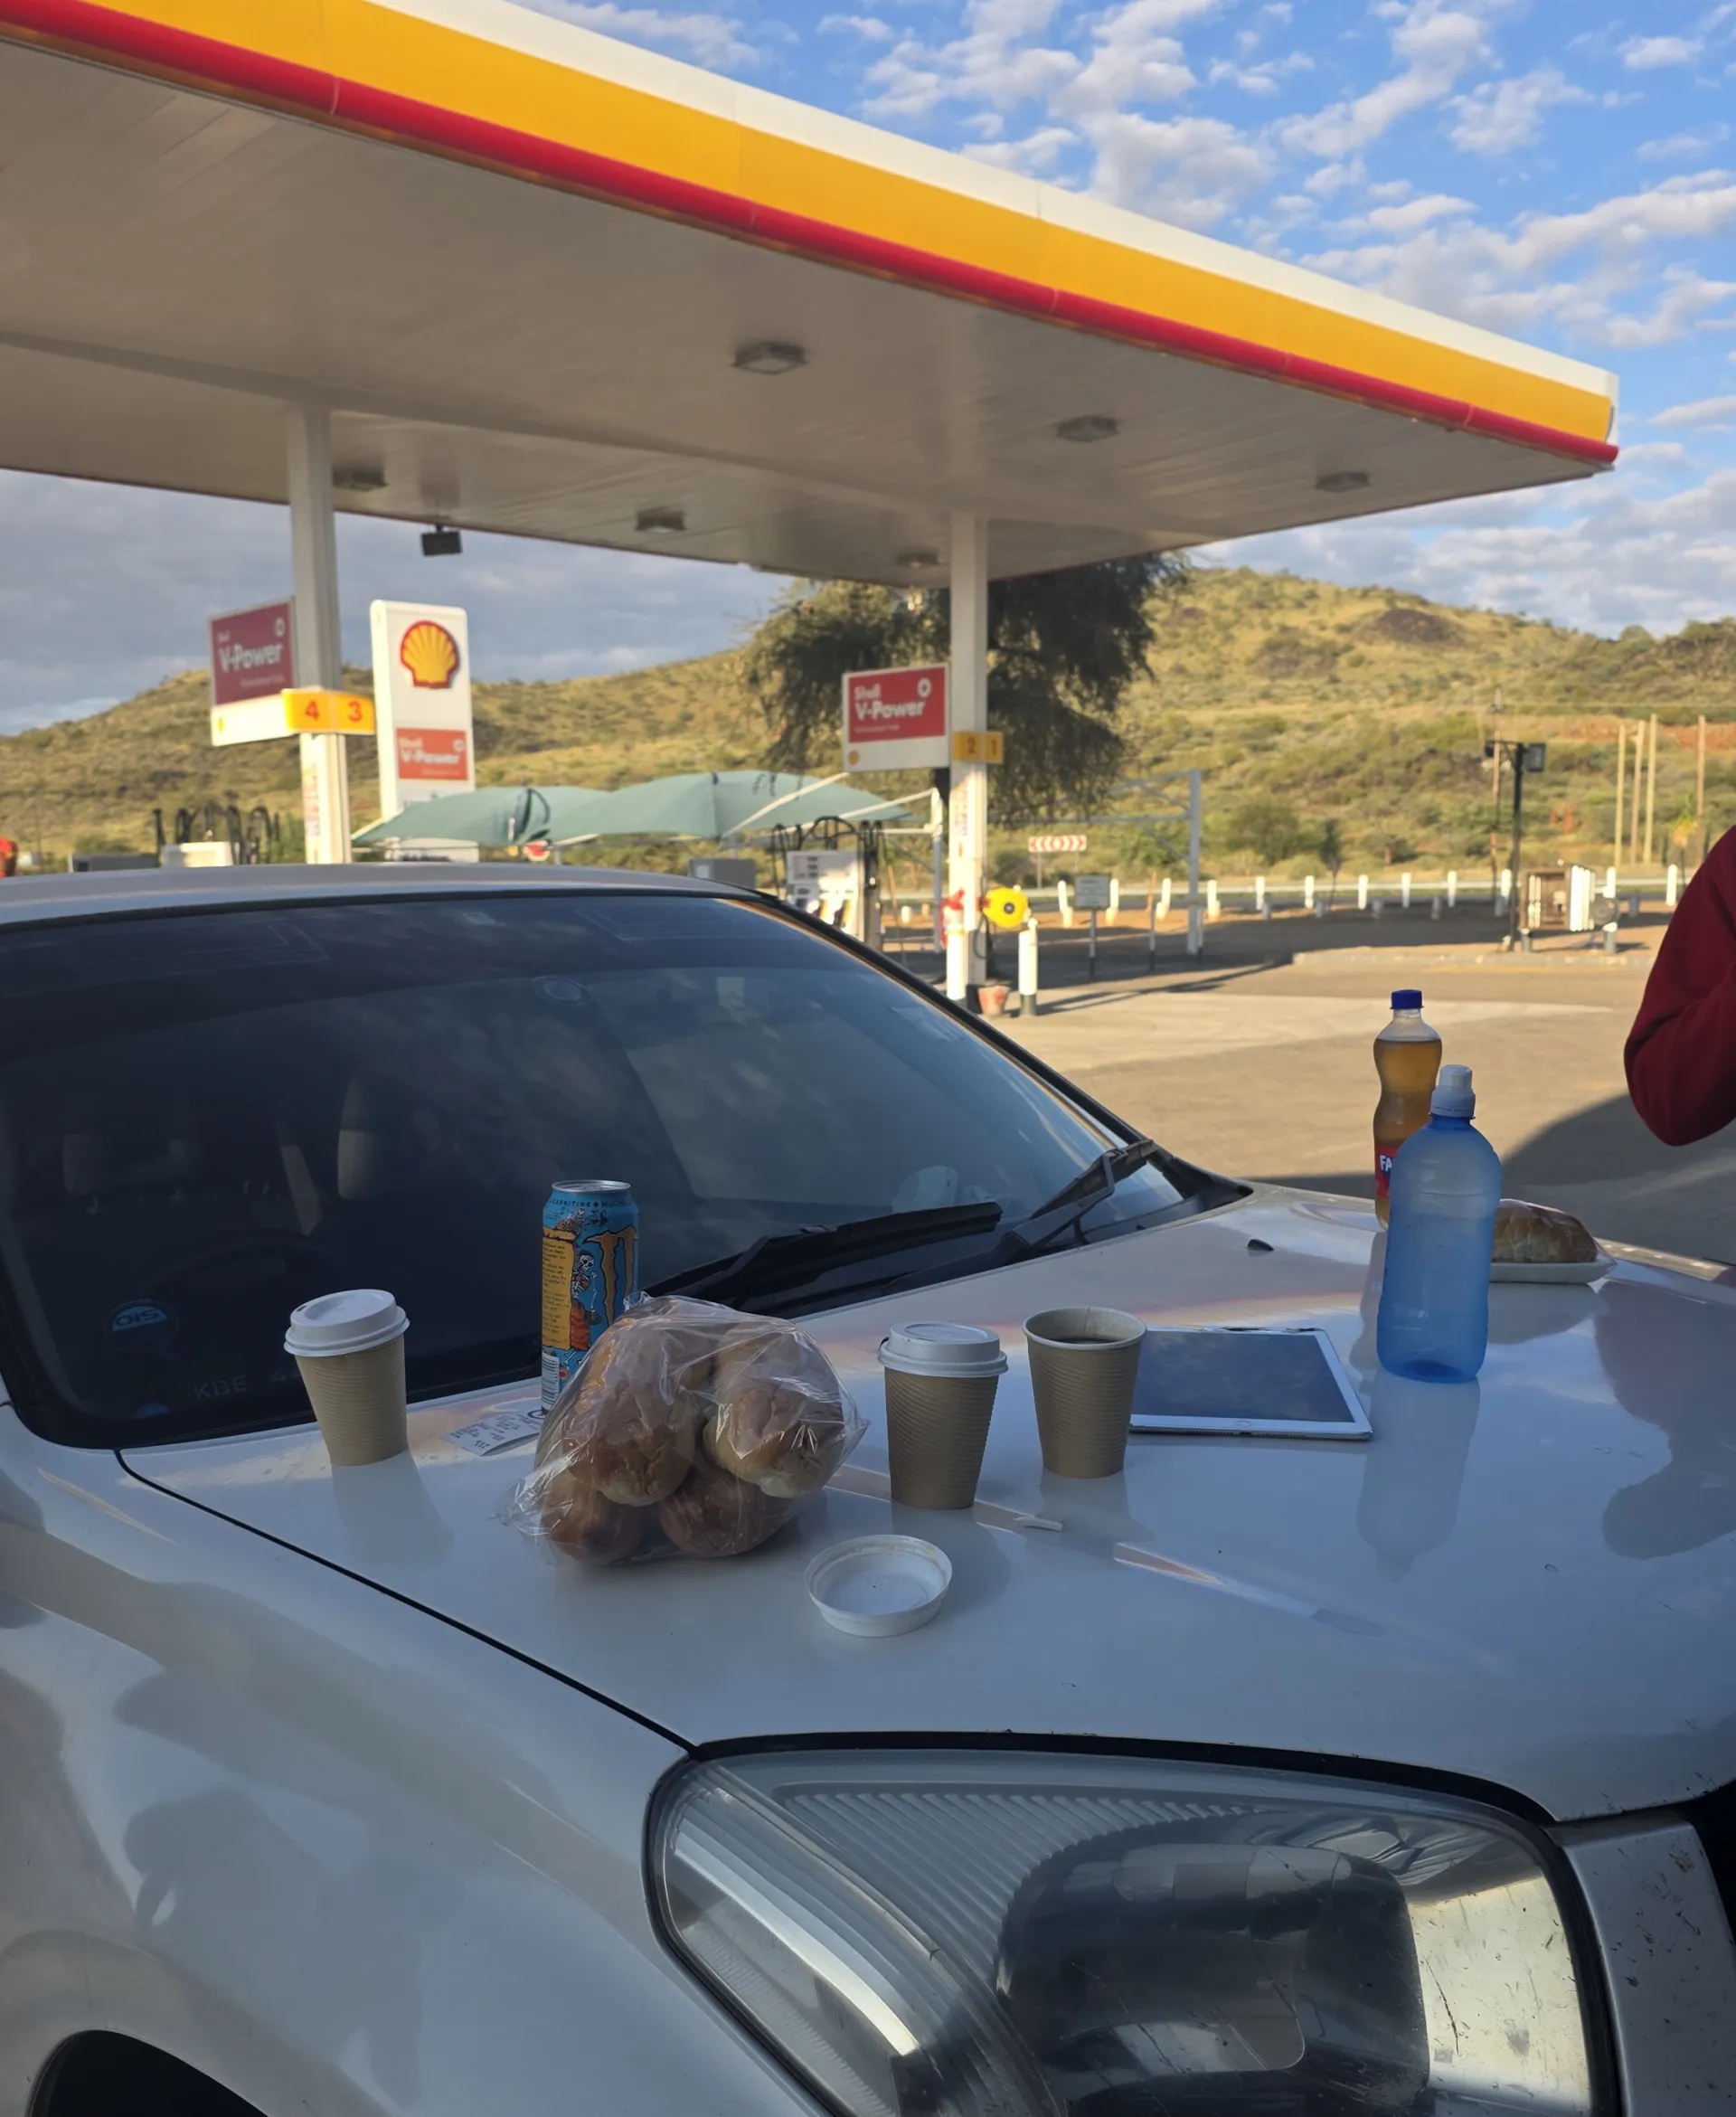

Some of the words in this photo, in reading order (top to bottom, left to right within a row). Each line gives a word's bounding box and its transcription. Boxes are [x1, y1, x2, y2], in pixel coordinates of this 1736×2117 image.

[218, 643, 284, 674] V-Power
[304, 701, 320, 722] 4
[347, 701, 363, 723] 3
[854, 700, 926, 721] V-Power
